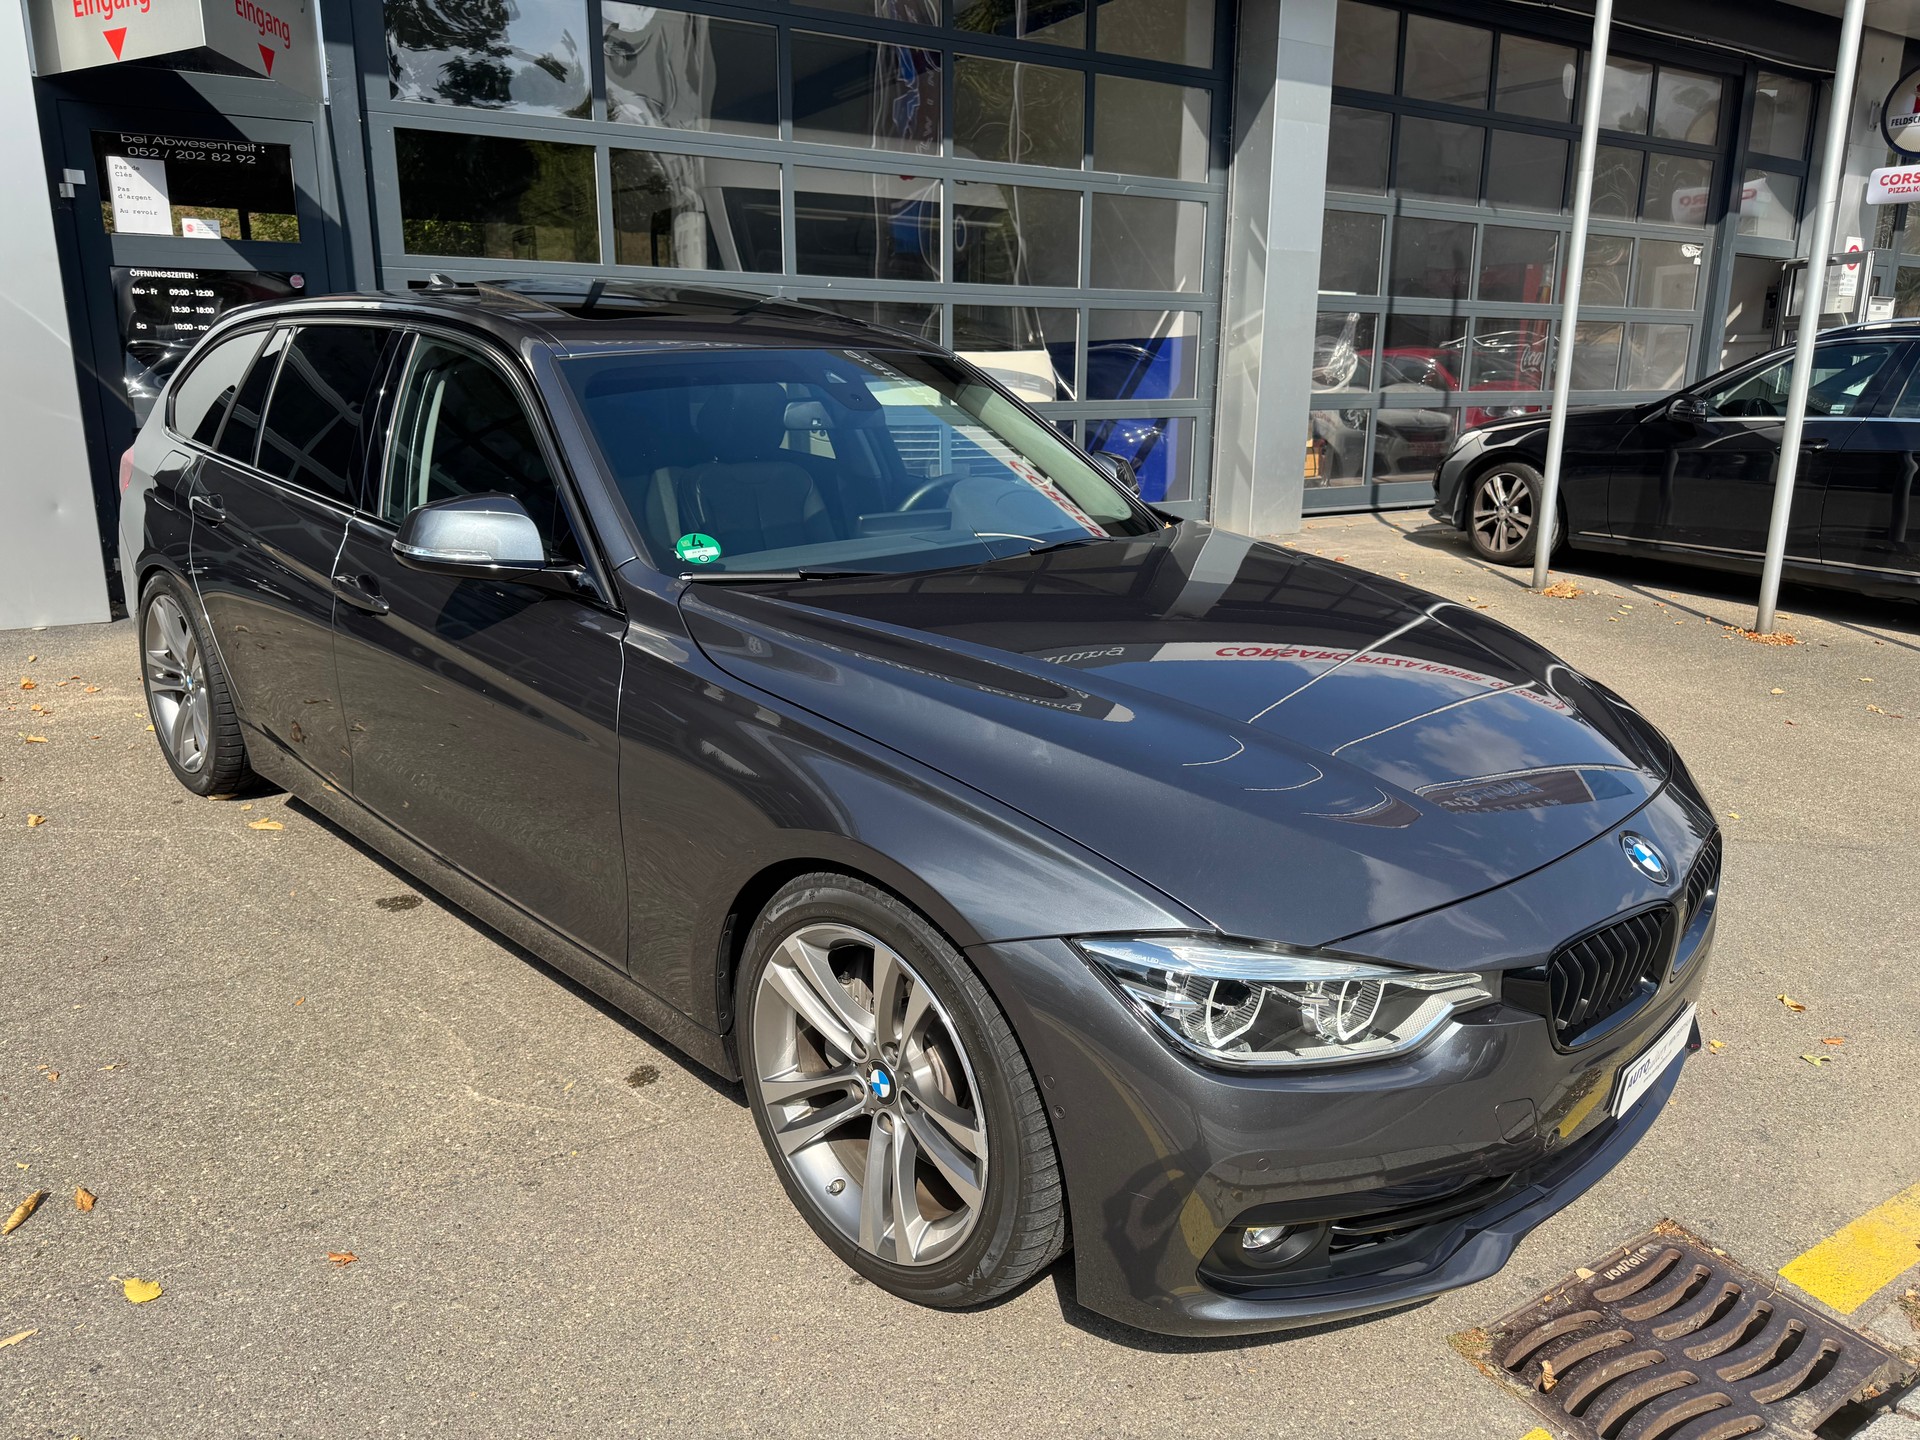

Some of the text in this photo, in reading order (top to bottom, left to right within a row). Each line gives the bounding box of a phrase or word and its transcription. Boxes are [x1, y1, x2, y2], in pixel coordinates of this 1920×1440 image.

[120, 133, 148, 144] bei
[152, 136, 257, 152] Abwesenheit
[127, 146, 160, 157] 052
[175, 150, 206, 160] 202
[211, 152, 232, 163] 82
[236, 154, 257, 164] 92
[1888, 186, 1911, 195] PIZZA
[118, 193, 152, 201] d'argent
[129, 268, 194, 279] ÖFFNUNGSZEITEN
[131, 287, 145, 295] Mo
[168, 289, 190, 297] 09:00
[195, 289, 214, 297] 12:00
[170, 305, 190, 313] 13:30
[195, 306, 215, 314] 18:00
[136, 322, 147, 330] Sa
[174, 323, 193, 331] 10:00
[692, 534, 704, 548] 4
